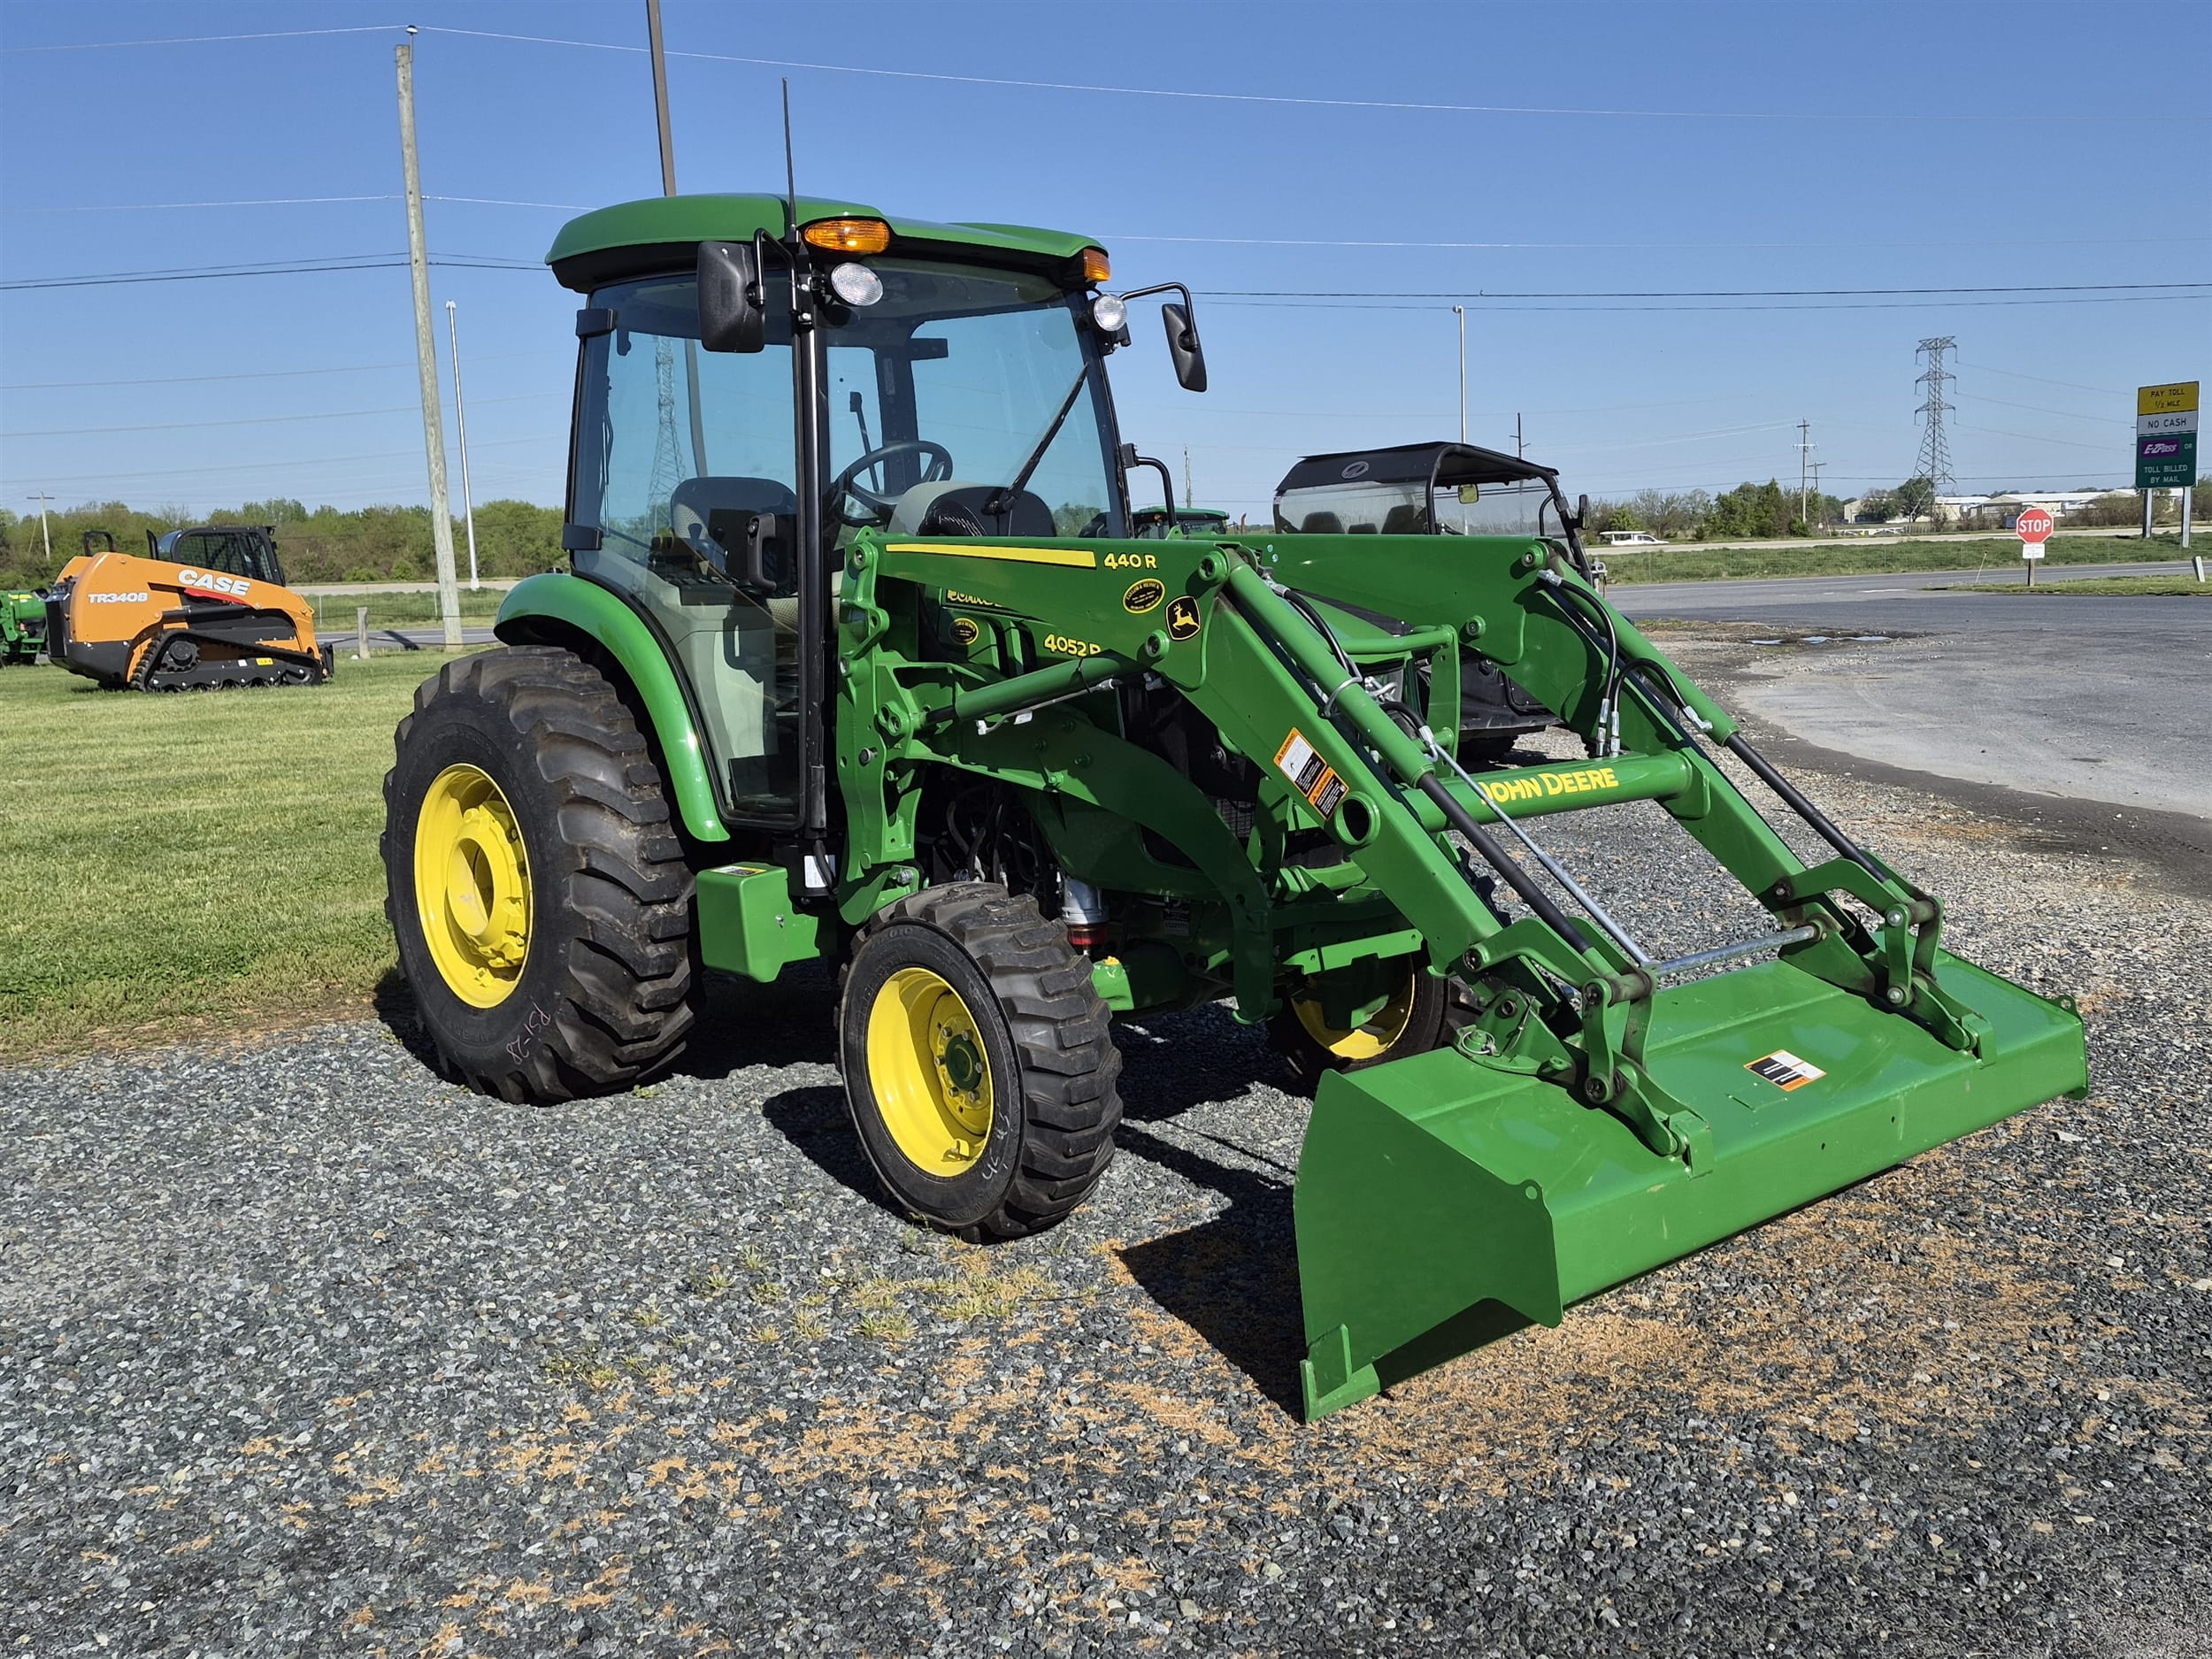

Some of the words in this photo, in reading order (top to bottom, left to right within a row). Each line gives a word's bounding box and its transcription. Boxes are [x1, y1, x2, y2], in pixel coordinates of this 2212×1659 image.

[2147, 419, 2160, 428] NO
[2163, 418, 2187, 427] CASH
[2019, 518, 2051, 533] STOP
[1103, 552, 1142, 570] 440
[1144, 554, 1157, 569] R
[178, 569, 251, 596] CASE
[88, 592, 150, 604] TR340B
[1044, 634, 1087, 657] 4052
[1538, 768, 1619, 796] DEERE
